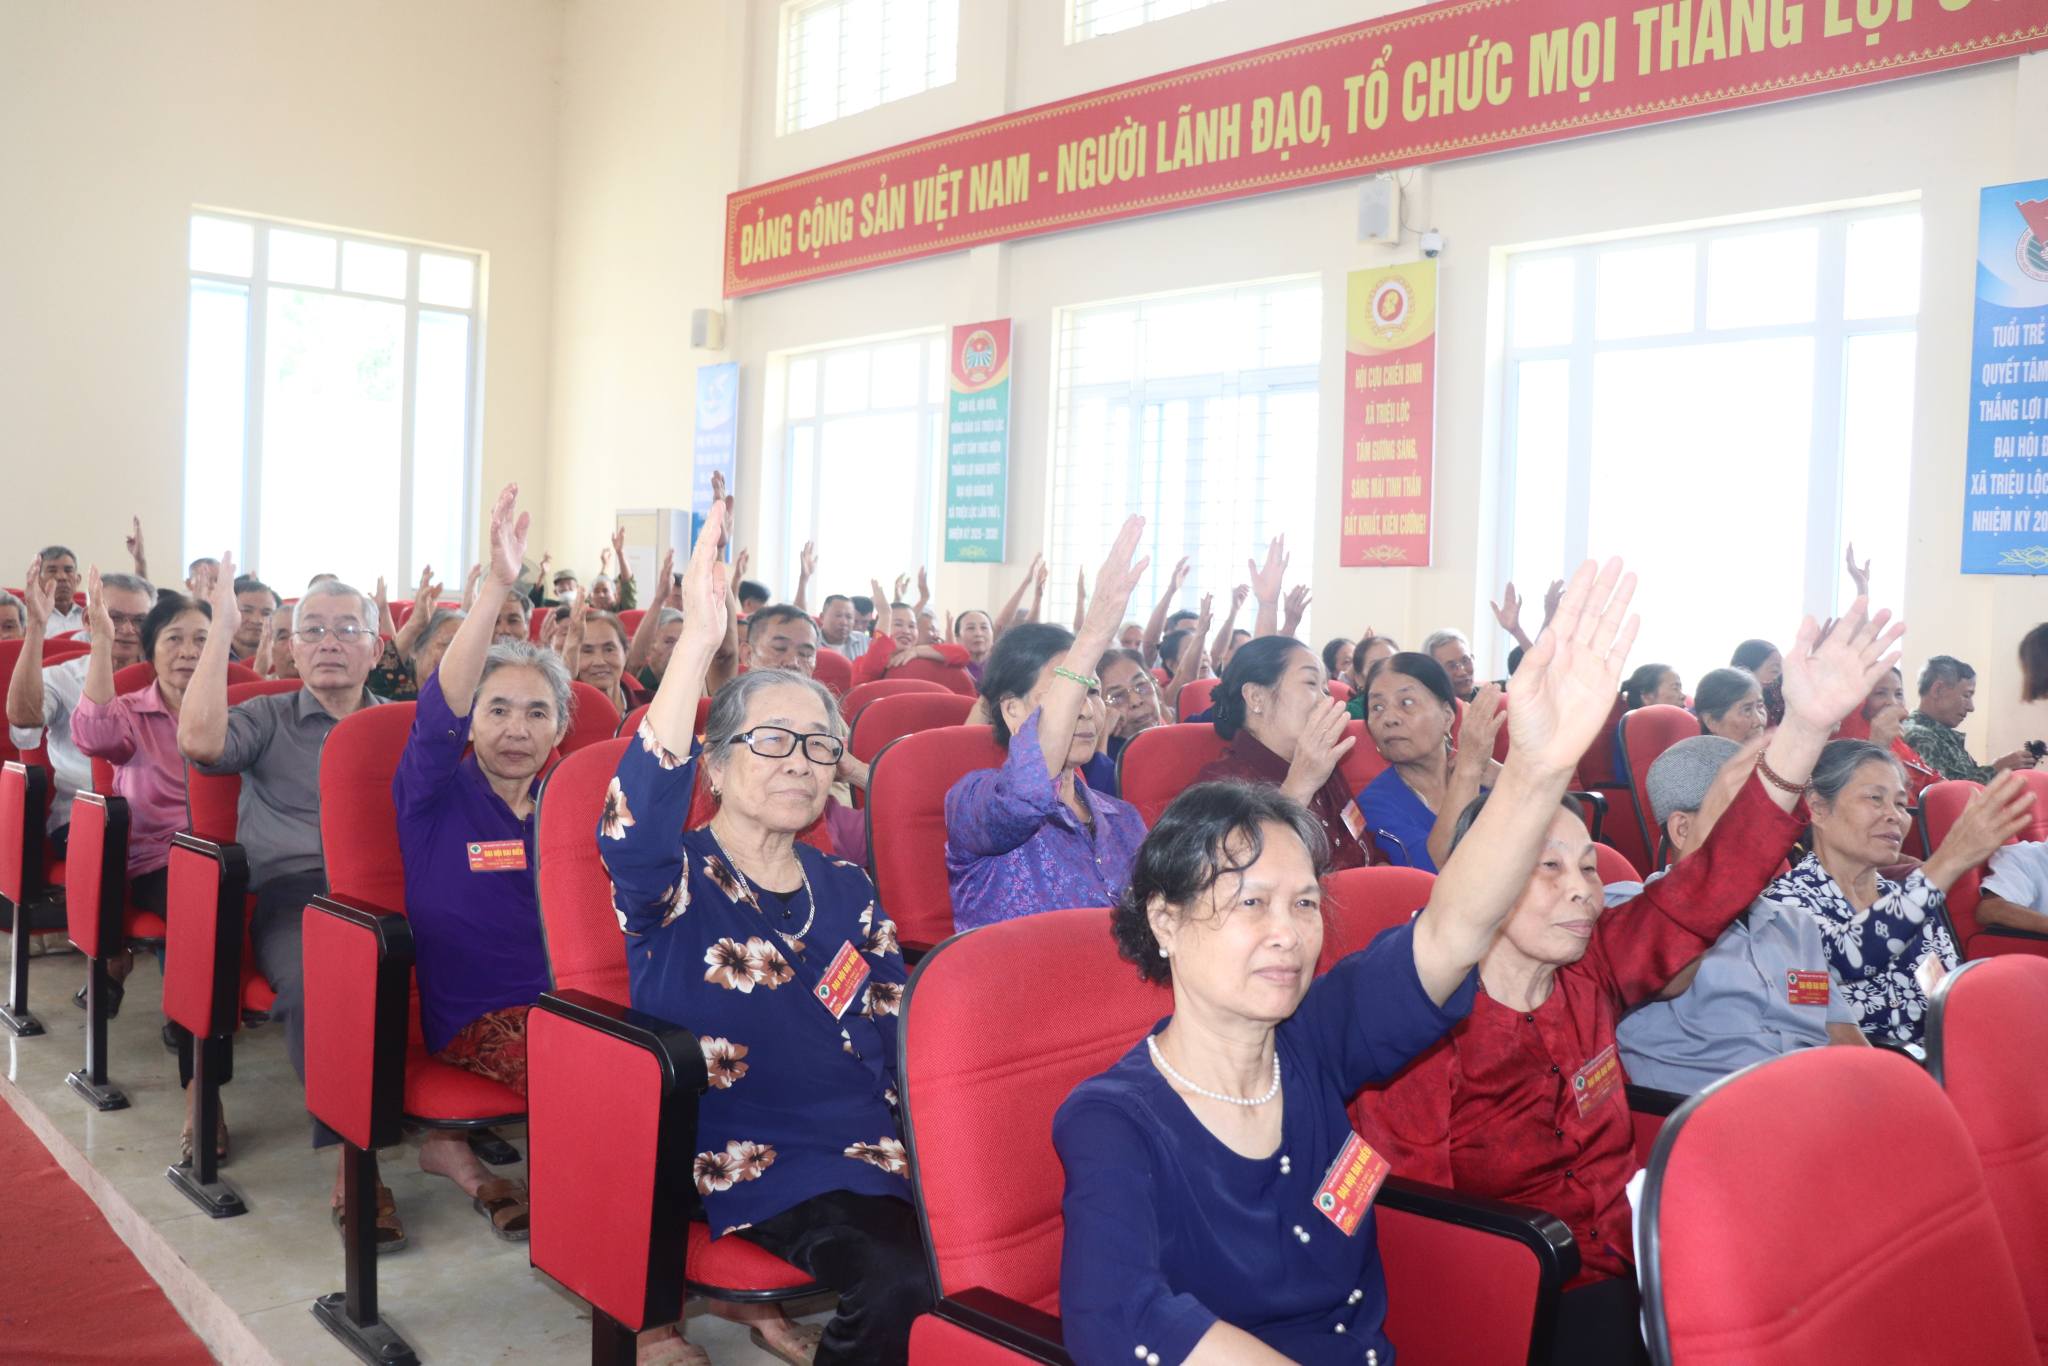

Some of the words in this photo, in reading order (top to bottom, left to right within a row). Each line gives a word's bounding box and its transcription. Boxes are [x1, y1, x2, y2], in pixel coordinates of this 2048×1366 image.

[740, 207, 792, 266] ĐẢNG
[798, 196, 854, 259] CỘNG
[859, 174, 907, 238] SẢN
[913, 164, 963, 231] VIỆT
[968, 153, 1030, 213] NAM
[1038, 170, 1049, 183] -
[1056, 116, 1147, 194] NGƯỜI
[1156, 103, 1241, 174] LÃNH
[1250, 84, 1331, 161] ĐẠO,
[1344, 44, 1393, 134] TỔ
[1402, 34, 1513, 122] CHỨC
[1528, 16, 1616, 103] MỌI
[1992, 316, 2021, 348] TUỔI
[2022, 316, 2046, 346] TRẺ
[1982, 355, 2021, 388] QUYẾT
[1979, 391, 2019, 422] THẮNG
[2022, 395, 2042, 425] LỢI
[1994, 436, 2015, 463] ĐẠI
[2017, 431, 2039, 462] HỘI
[1970, 469, 1987, 495] XÃ
[1990, 468, 2025, 499] TRIỆU
[1972, 505, 2012, 537] NHIỆM
[2014, 505, 2031, 532] KỲ
